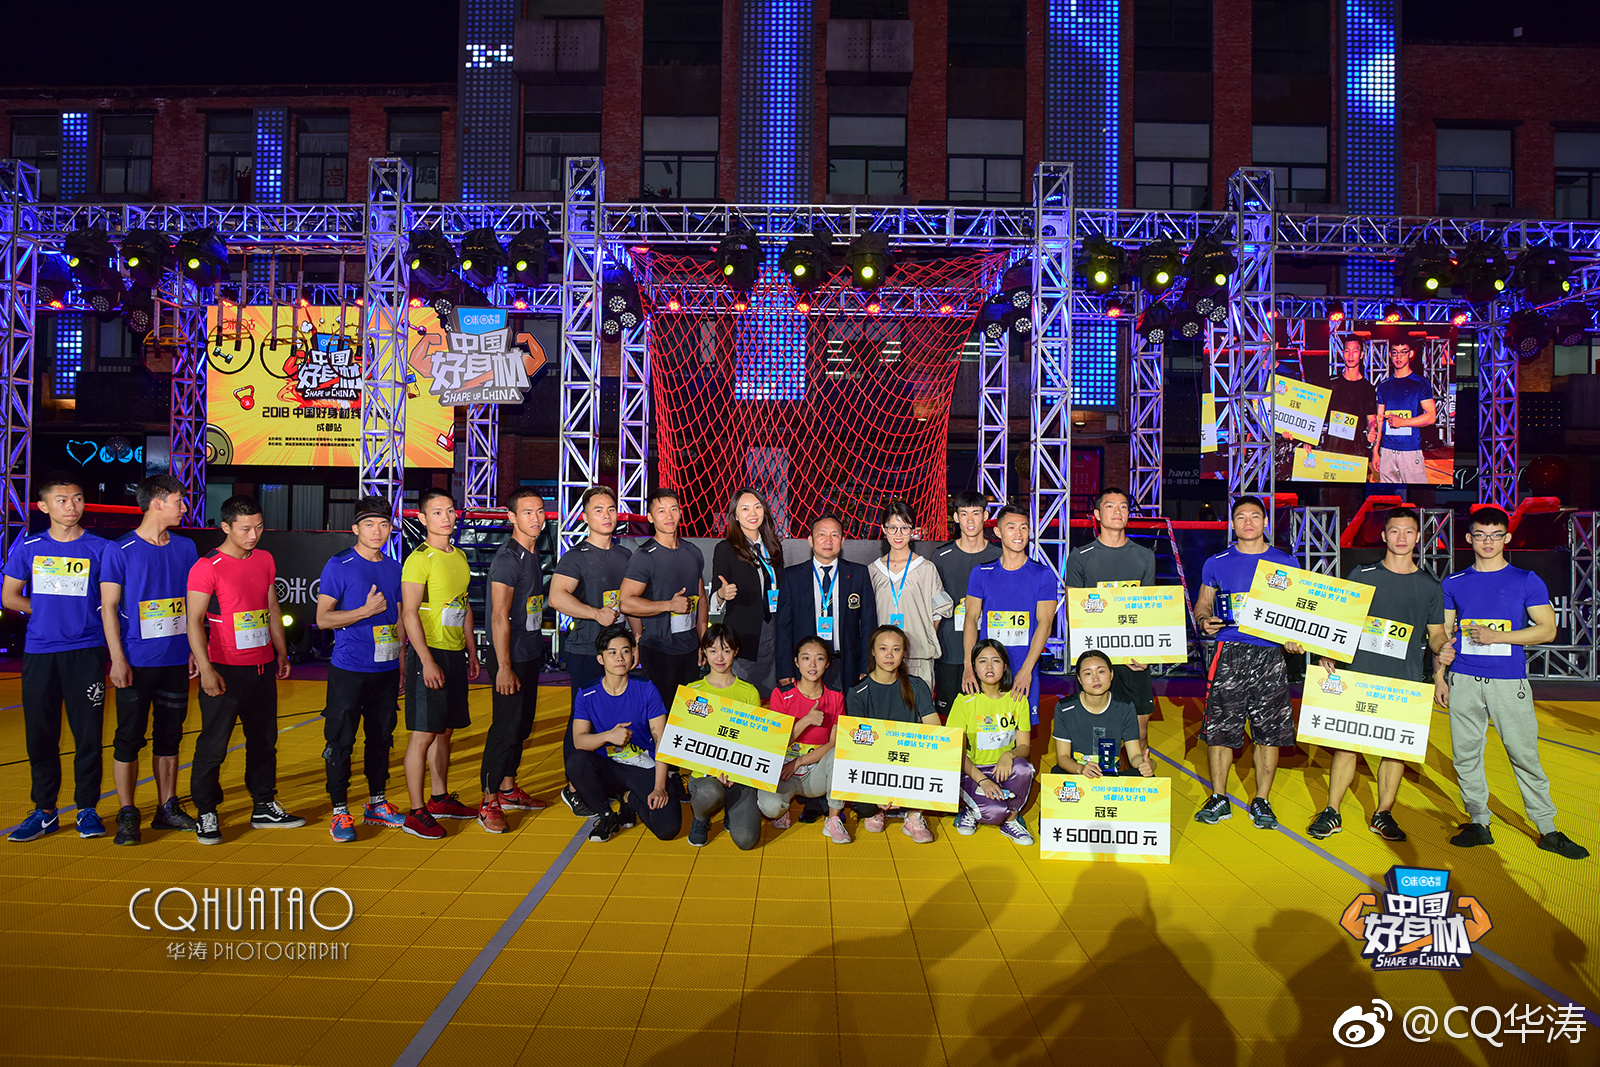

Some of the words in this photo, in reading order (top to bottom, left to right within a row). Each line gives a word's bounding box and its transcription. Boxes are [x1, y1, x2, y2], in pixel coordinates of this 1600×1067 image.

[450, 328, 509, 354] 中国
[431, 348, 530, 391] 好身材
[262, 406, 290, 418] 2018
[316, 423, 342, 432] 成都站
[1344, 416, 1355, 426] 20
[65, 561, 83, 573] 10
[169, 601, 182, 613] 12
[1295, 597, 1318, 611] 冠军
[1010, 615, 1025, 626] 16
[1118, 614, 1138, 625] 季军
[1264, 611, 1330, 639] 5000.00
[1332, 628, 1348, 644] 元
[1388, 625, 1407, 638] 20
[1097, 634, 1154, 648] 1000.00
[1158, 634, 1172, 648] 元
[1355, 701, 1378, 714] 亚军
[1000, 715, 1016, 728] 04
[717, 725, 740, 740] 亚军
[1324, 717, 1395, 741] 2000.00
[1399, 729, 1415, 745] 元
[684, 738, 753, 768] 2000.00
[755, 757, 770, 774] 元
[887, 750, 910, 763] 季军
[861, 770, 924, 791] 1000.00
[929, 777, 943, 793] 元
[1094, 806, 1117, 818] 冠军
[1066, 828, 1138, 845] 5000.00
[1143, 830, 1157, 846] 元
